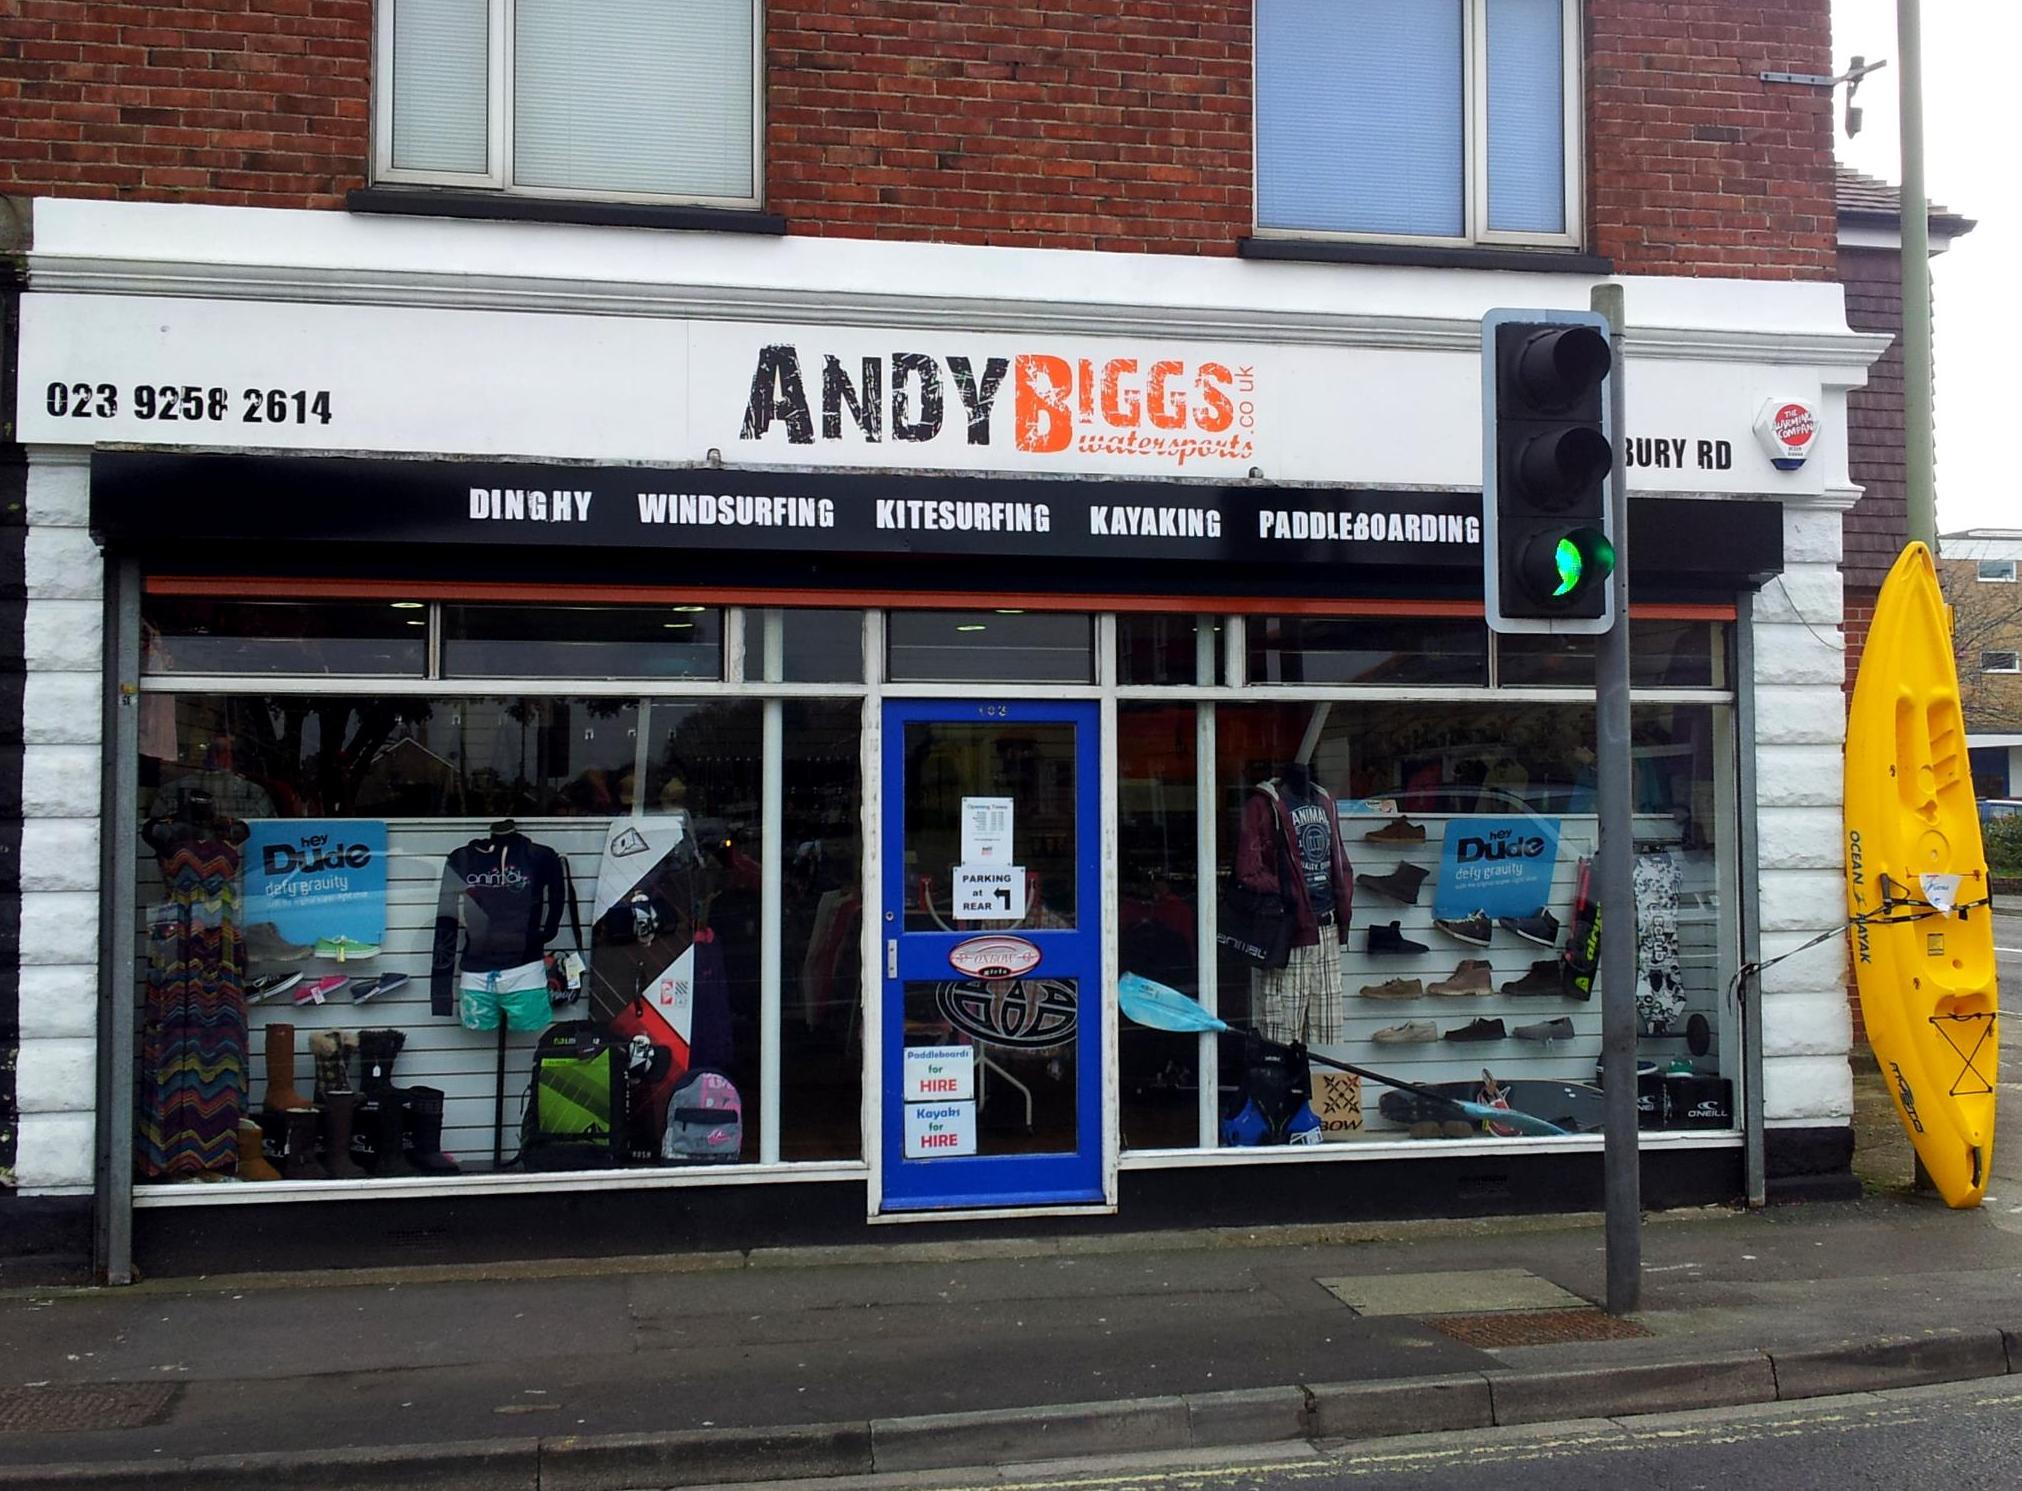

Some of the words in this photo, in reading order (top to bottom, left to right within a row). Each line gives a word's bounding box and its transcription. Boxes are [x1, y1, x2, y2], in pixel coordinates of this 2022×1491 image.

[46, 382, 118, 418] 023
[134, 385, 228, 422] 9258
[243, 388, 333, 425] 2614
[1784, 408, 1799, 419] THE
[1078, 430, 1254, 466] watersports
[1697, 439, 1732, 470] RD
[469, 486, 592, 523] DINGHY
[638, 492, 835, 529] WINDSURFING
[876, 499, 1051, 534] KITESURFING
[1090, 505, 1222, 539] KAYAKING
[1258, 510, 1480, 545] PADDLEBOARDING
[1290, 804, 1330, 827] ANIMAL
[301, 833, 329, 848] hey
[1490, 828, 1513, 841] hey
[1456, 836, 1545, 864] Dude
[262, 842, 372, 876] Dude
[1849, 830, 1864, 886] OCEAN
[962, 873, 1012, 884] PARKING
[1455, 866, 1481, 881] defy
[1484, 862, 1523, 880] gravity
[300, 874, 348, 896] gravity
[972, 887, 983, 897] at
[963, 902, 993, 911] REAR
[907, 1048, 969, 1060] Paddleboards
[928, 1064, 943, 1074] for
[920, 1079, 958, 1093] HIRE
[917, 1106, 961, 1121] Kayaks
[928, 1122, 944, 1132] for
[1319, 1119, 1363, 1132] BOW
[920, 1134, 958, 1149] HIRE
